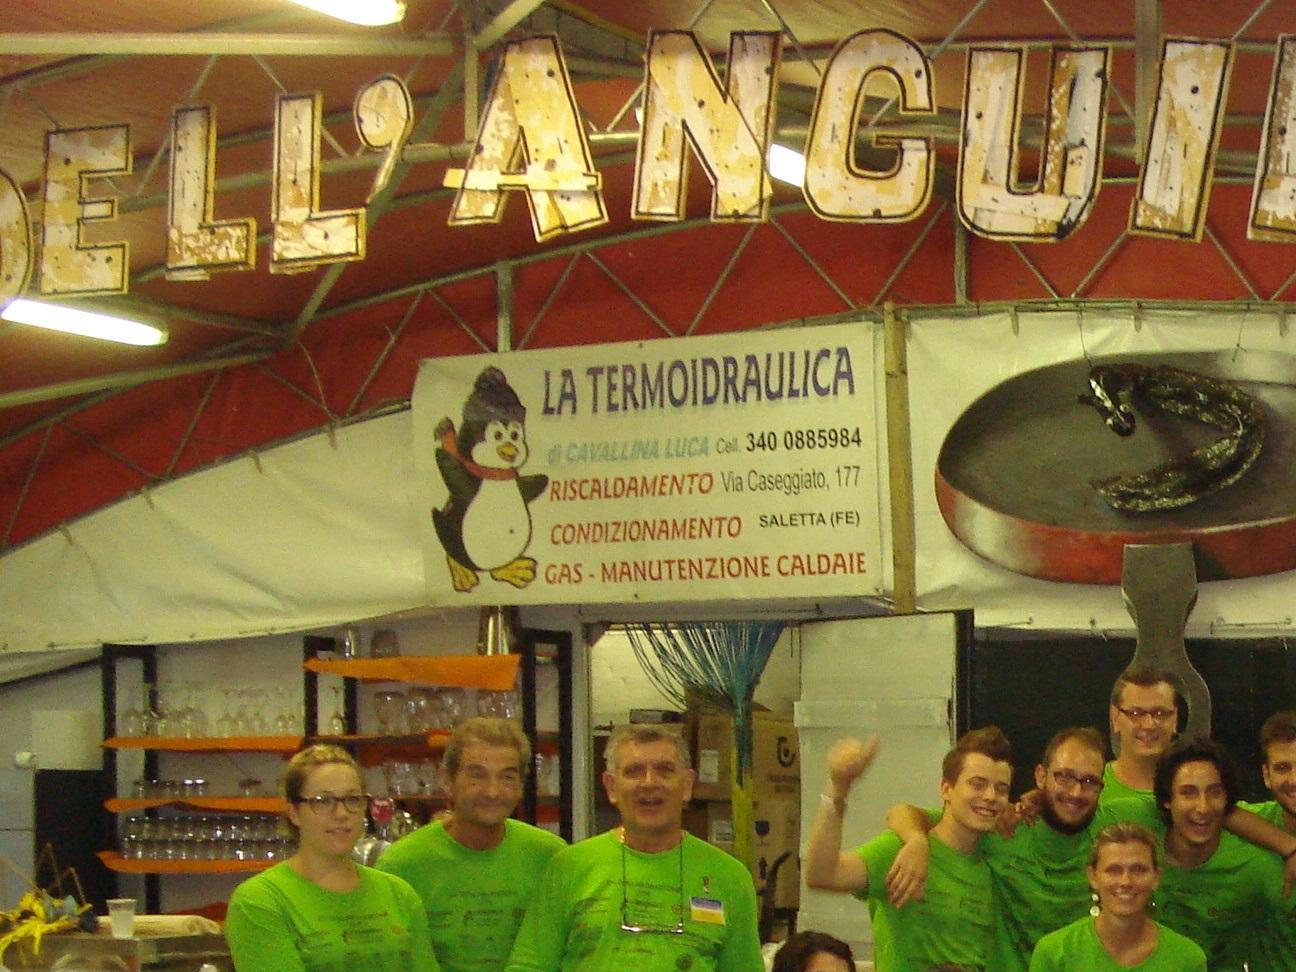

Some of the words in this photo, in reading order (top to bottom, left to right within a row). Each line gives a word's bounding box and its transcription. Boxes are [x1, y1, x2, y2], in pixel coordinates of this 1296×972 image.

[541, 369, 577, 415] LA
[586, 347, 855, 413] TERMOIDRAULICA
[566, 439, 660, 463] CAVALLINA
[665, 436, 710, 459] LUCA
[746, 431, 777, 452] 340
[784, 427, 862, 450] 0885984
[549, 471, 714, 501] RISCALDAMENTO
[721, 470, 743, 493] Via
[747, 468, 830, 496] Caseggiato,
[835, 466, 861, 488] 177
[551, 516, 742, 546] CONDIZIONAMENTO
[759, 512, 826, 528] SALETTA
[830, 511, 860, 527] (FE)
[544, 563, 583, 584] GAS
[601, 556, 771, 583] MANUTENZIONE
[776, 552, 867, 577] CALDAIE
